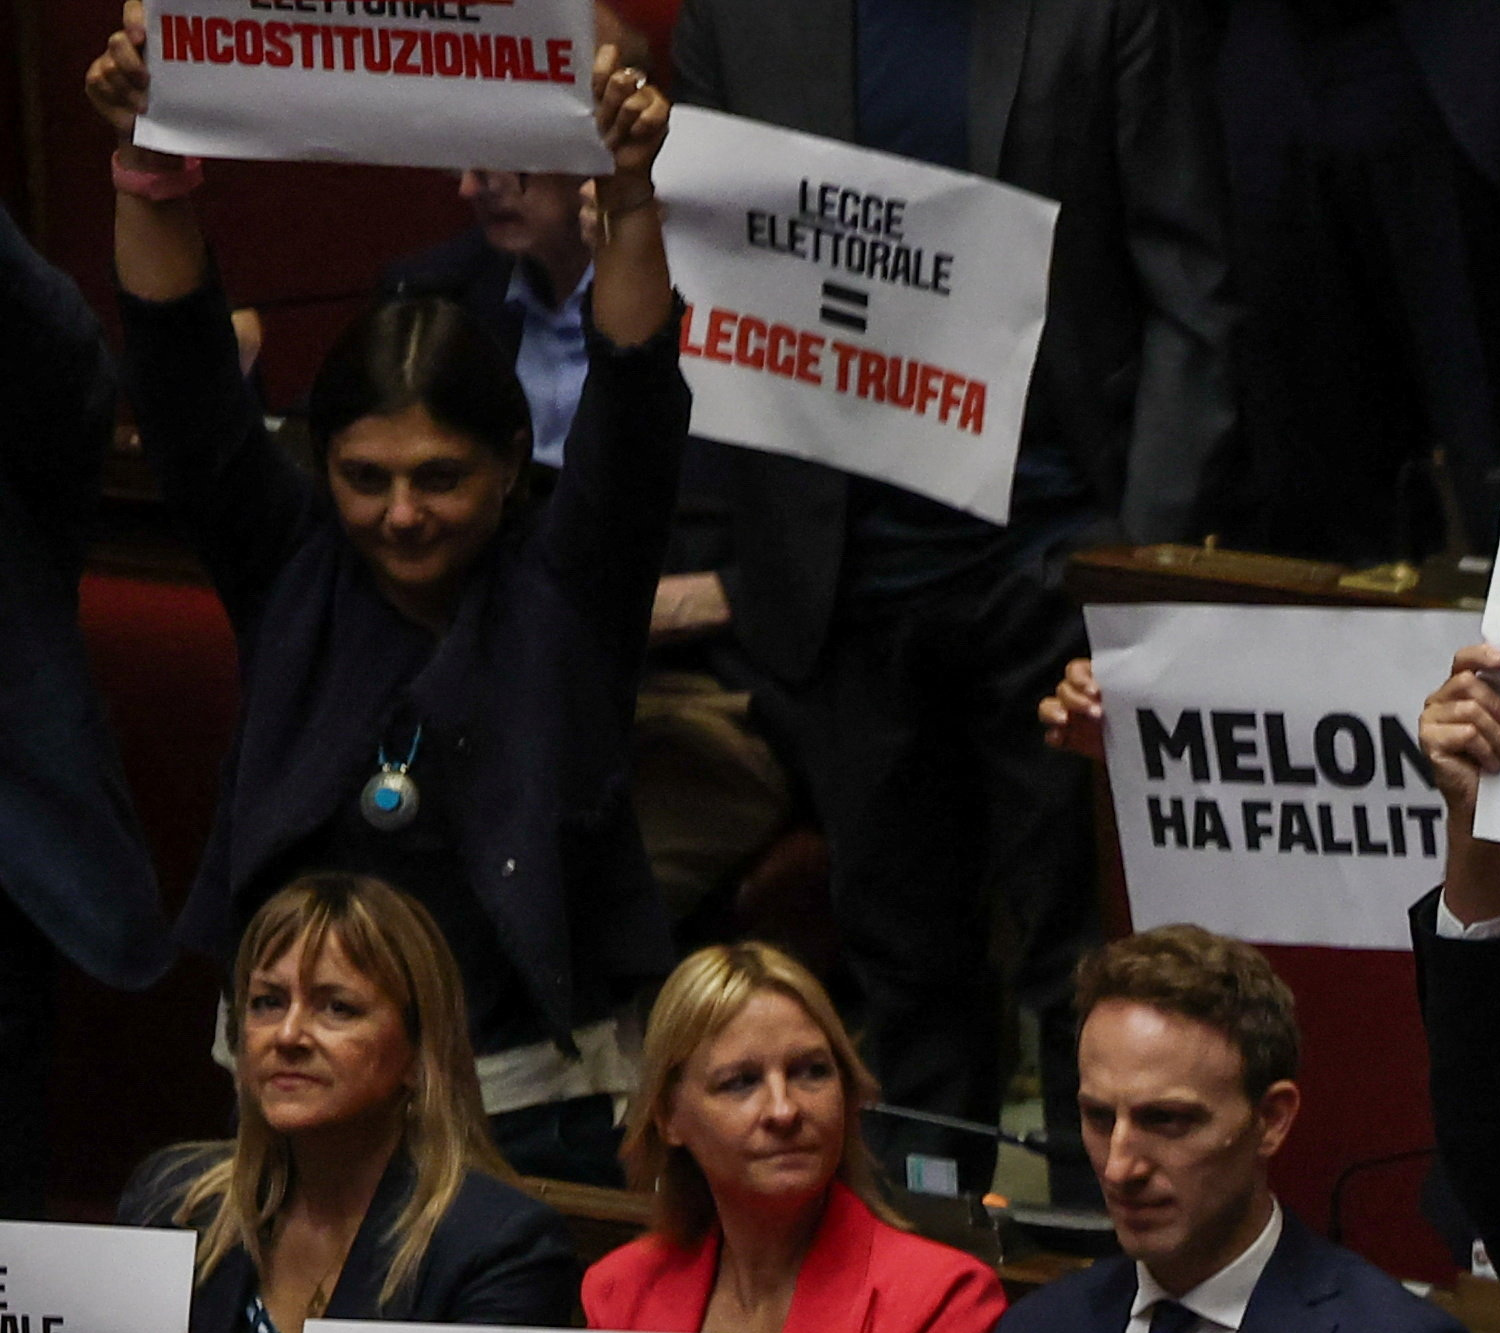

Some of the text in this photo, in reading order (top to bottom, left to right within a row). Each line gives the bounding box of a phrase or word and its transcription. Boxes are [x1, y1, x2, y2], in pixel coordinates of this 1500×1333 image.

[160, 14, 576, 84] INCOSTITUZIONALE
[799, 180, 905, 239] LEGGE
[746, 211, 953, 295] ELETTORALE
[677, 302, 988, 436] LEGGE TRUFFA
[1136, 707, 1440, 789] MELON
[1147, 795, 1443, 858] HA FALLIT
